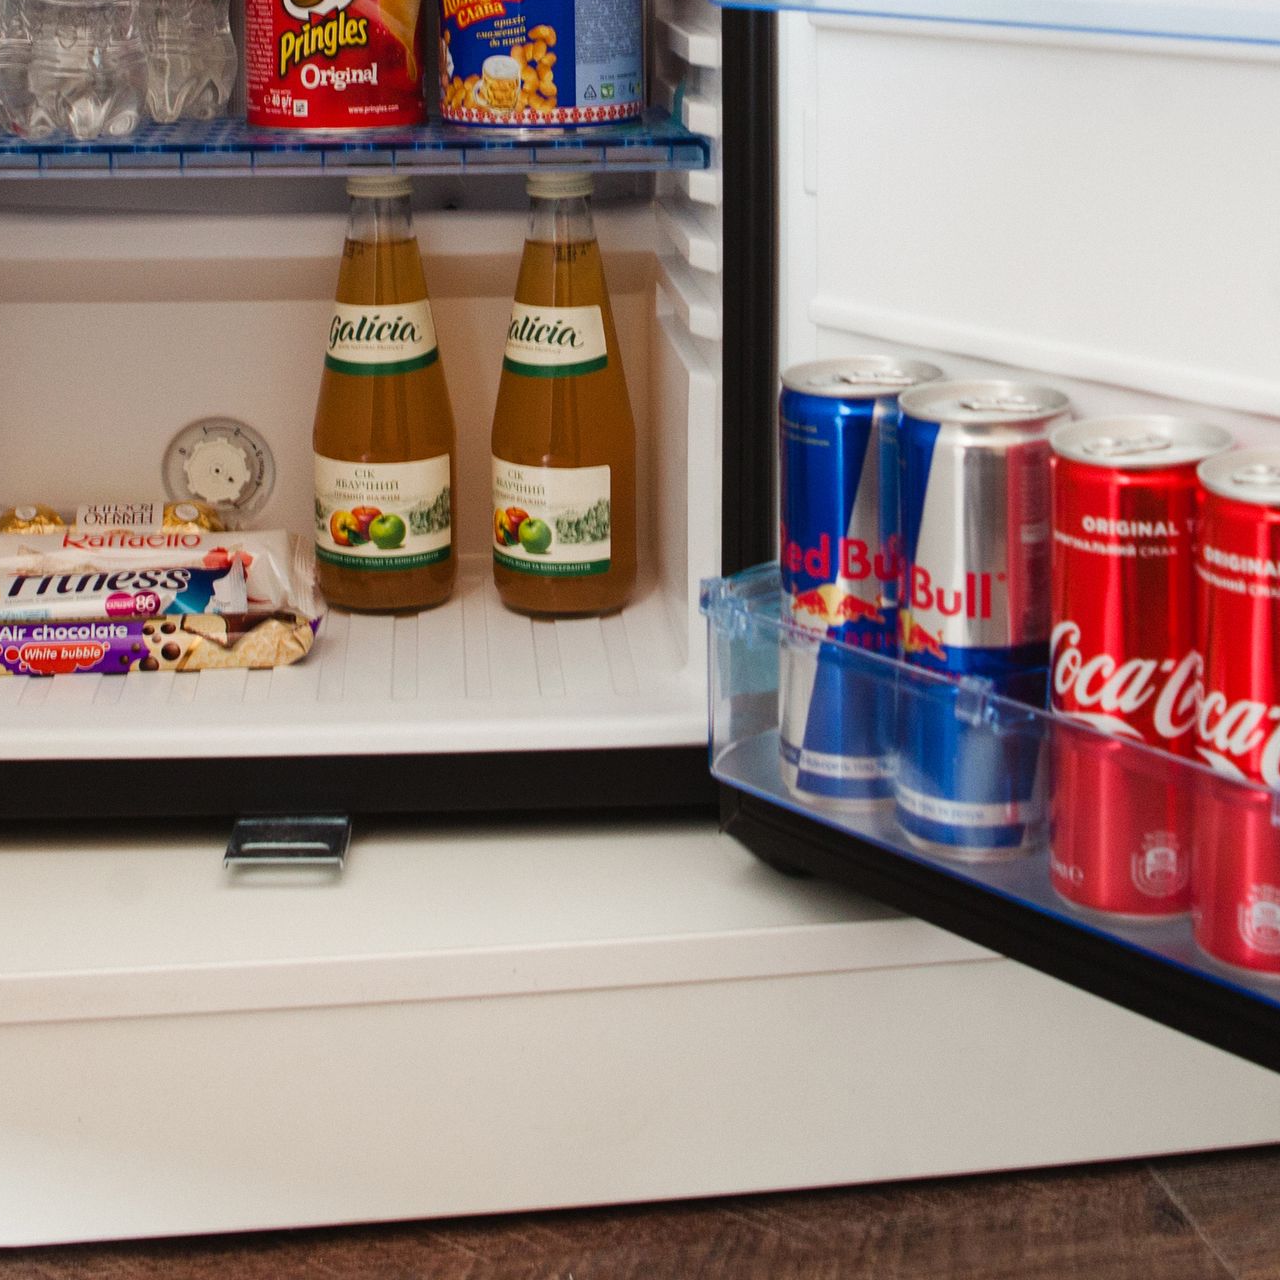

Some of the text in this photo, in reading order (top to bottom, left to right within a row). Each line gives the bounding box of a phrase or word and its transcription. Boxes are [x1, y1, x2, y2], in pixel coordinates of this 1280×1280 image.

[280, 11, 368, 76] Pringles
[300, 62, 379, 91] Original
[348, 104, 400, 115] www.pringles.com
[329, 314, 423, 351] Galicia
[508, 314, 584, 348] alicia
[1081, 515, 1180, 538] ORIGINAL
[62, 532, 202, 549] Raffaello
[782, 533, 898, 581] ed Bu
[135, 594, 156, 613] 86
[911, 565, 992, 620] Bull
[32, 623, 129, 641] chocolate
[24, 645, 101, 661] White bubble
